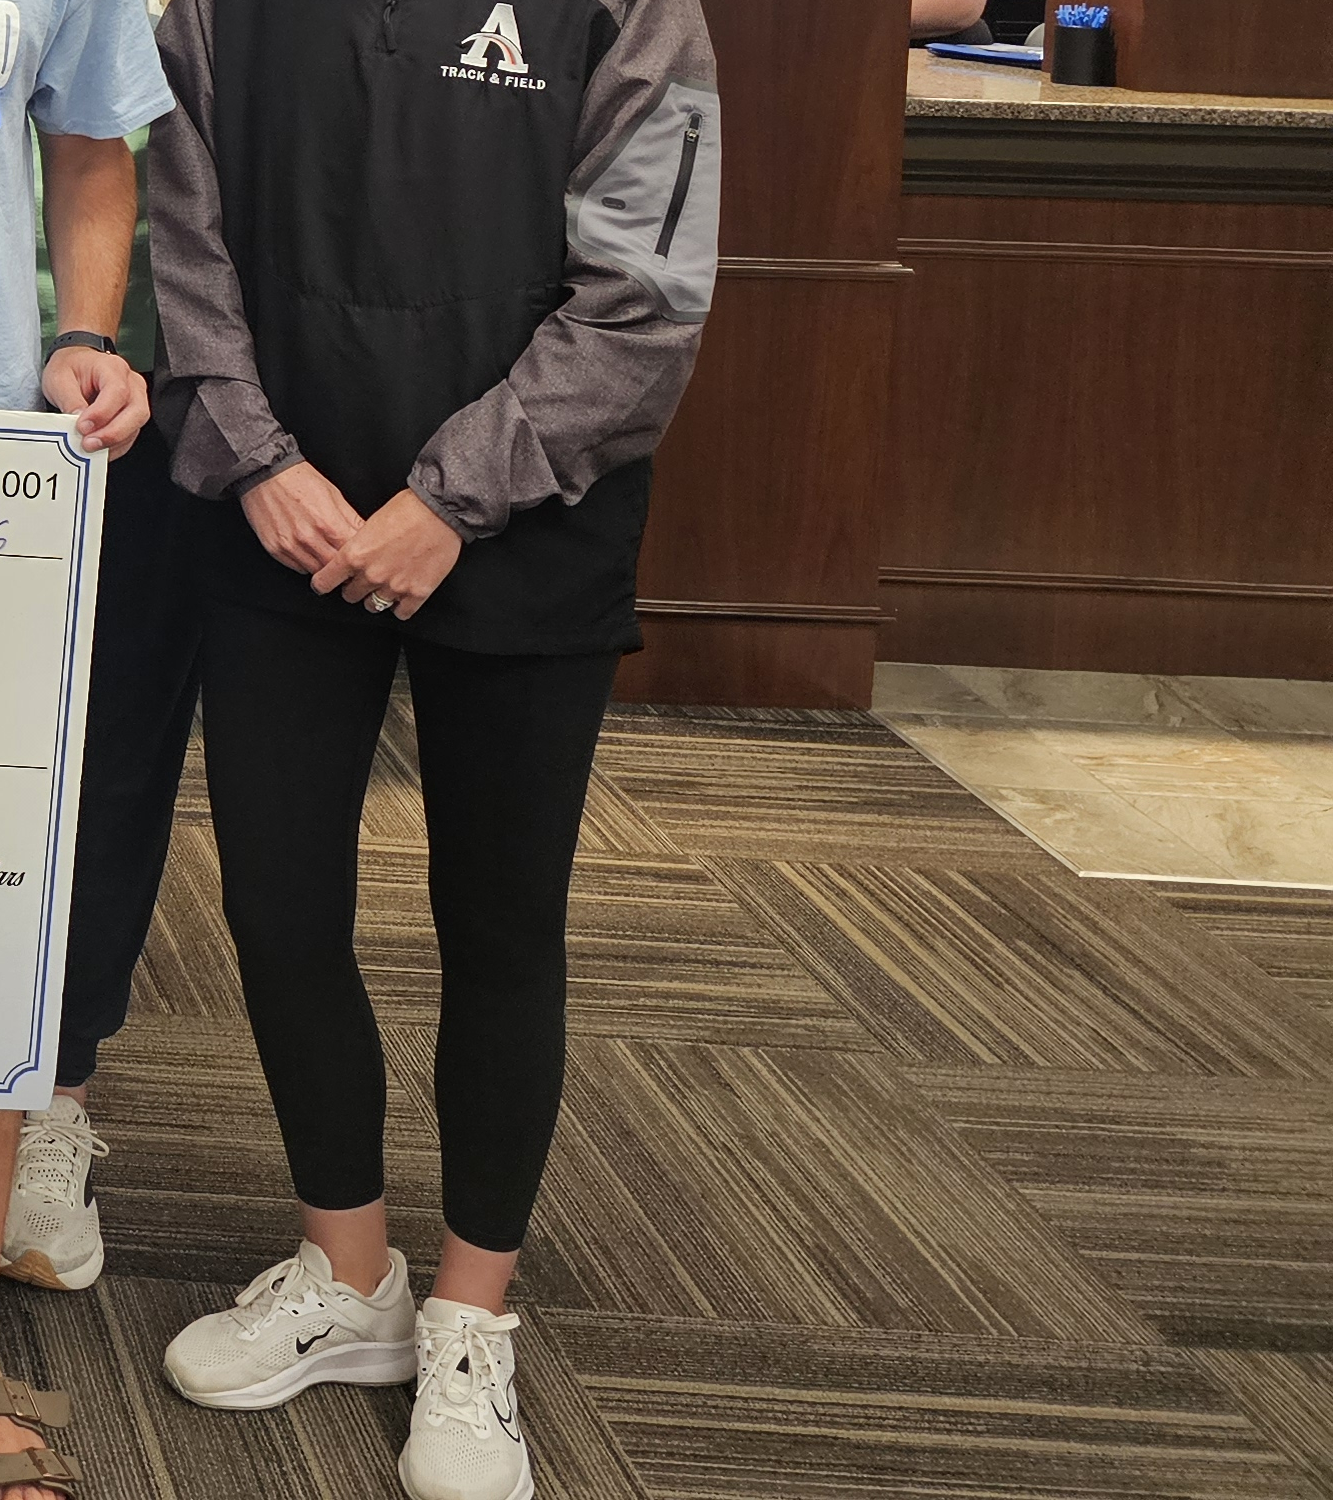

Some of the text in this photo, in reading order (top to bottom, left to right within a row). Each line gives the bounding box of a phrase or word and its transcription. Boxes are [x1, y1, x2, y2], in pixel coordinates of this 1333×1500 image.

[440, 65, 547, 90] TRACK & FIELD
